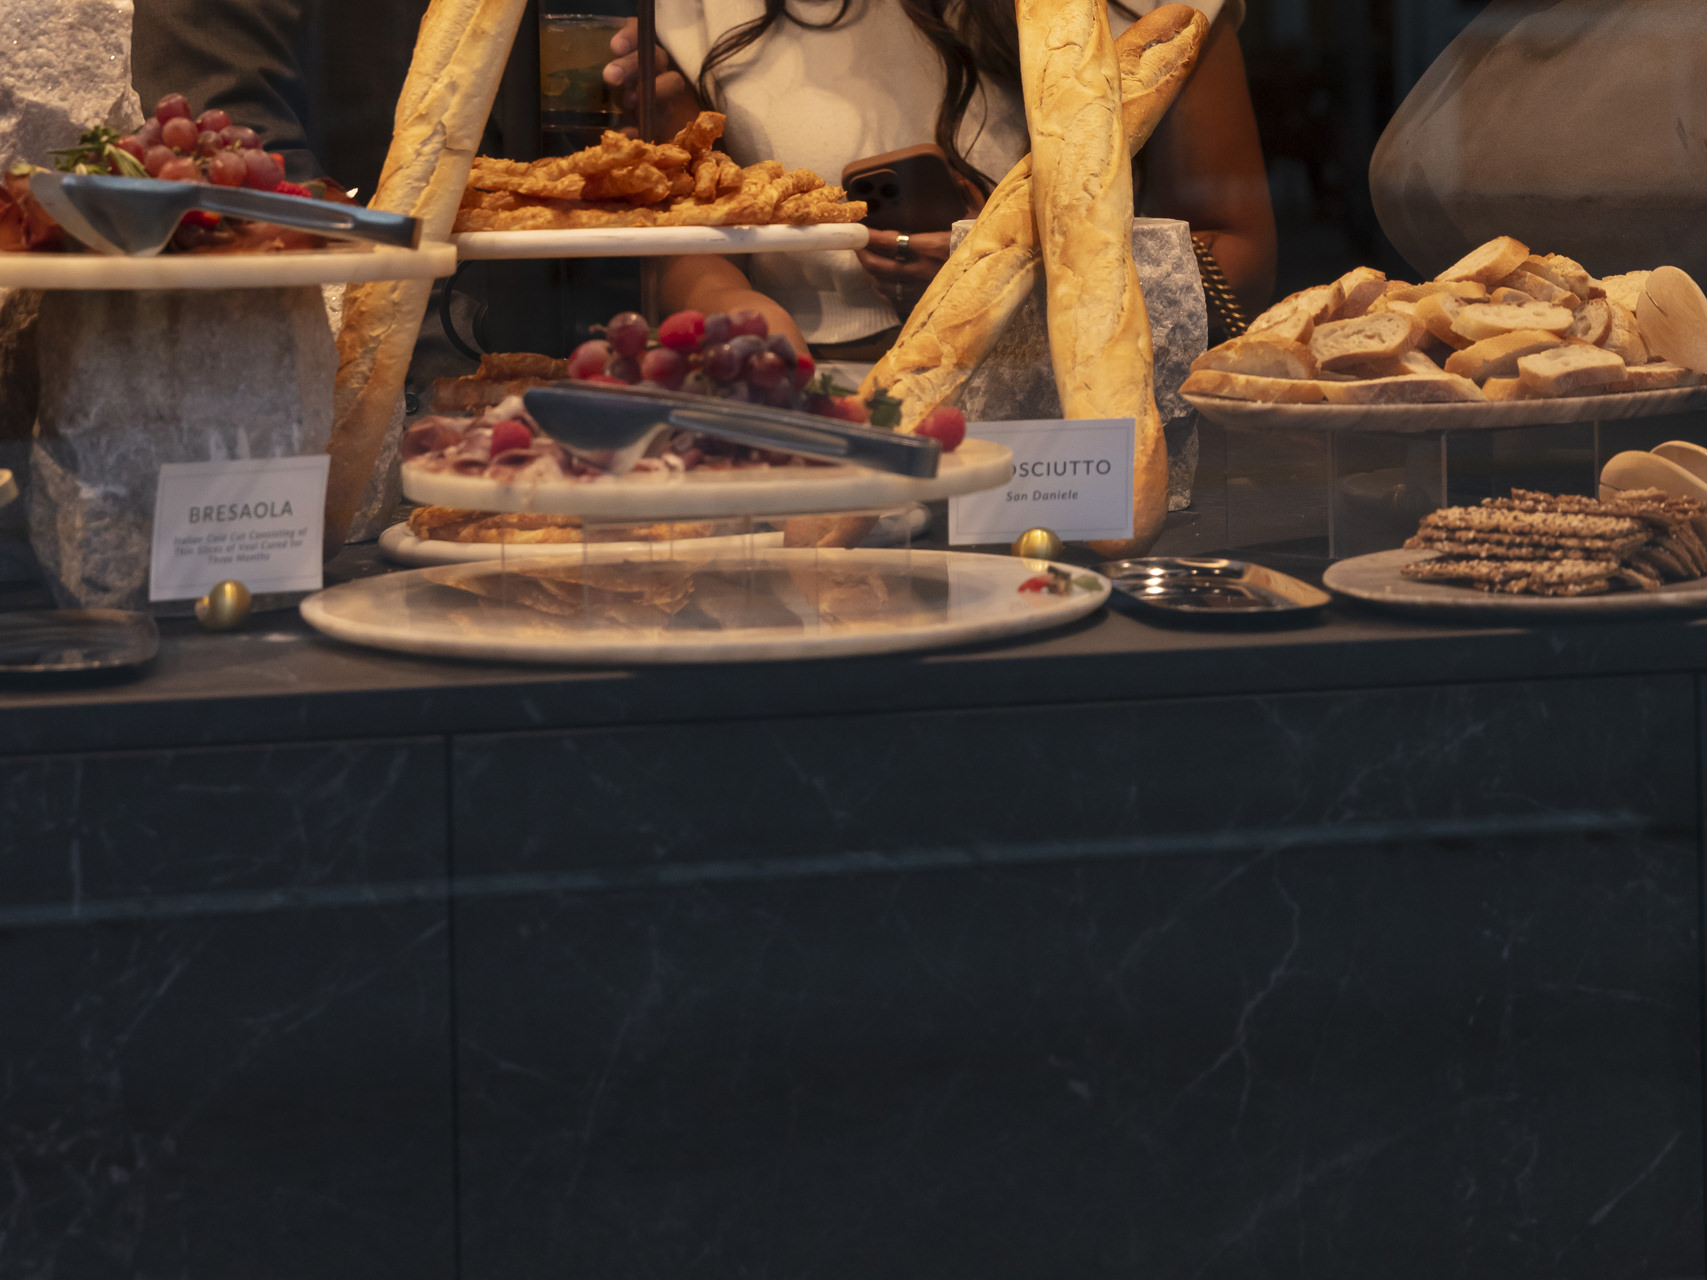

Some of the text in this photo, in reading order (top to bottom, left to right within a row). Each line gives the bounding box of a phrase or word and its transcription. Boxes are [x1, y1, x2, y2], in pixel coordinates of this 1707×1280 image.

[1012, 459, 1111, 477] SCIUTTO
[1006, 489, 1079, 501] San Daniele
[189, 500, 294, 524] BRESAOLA
